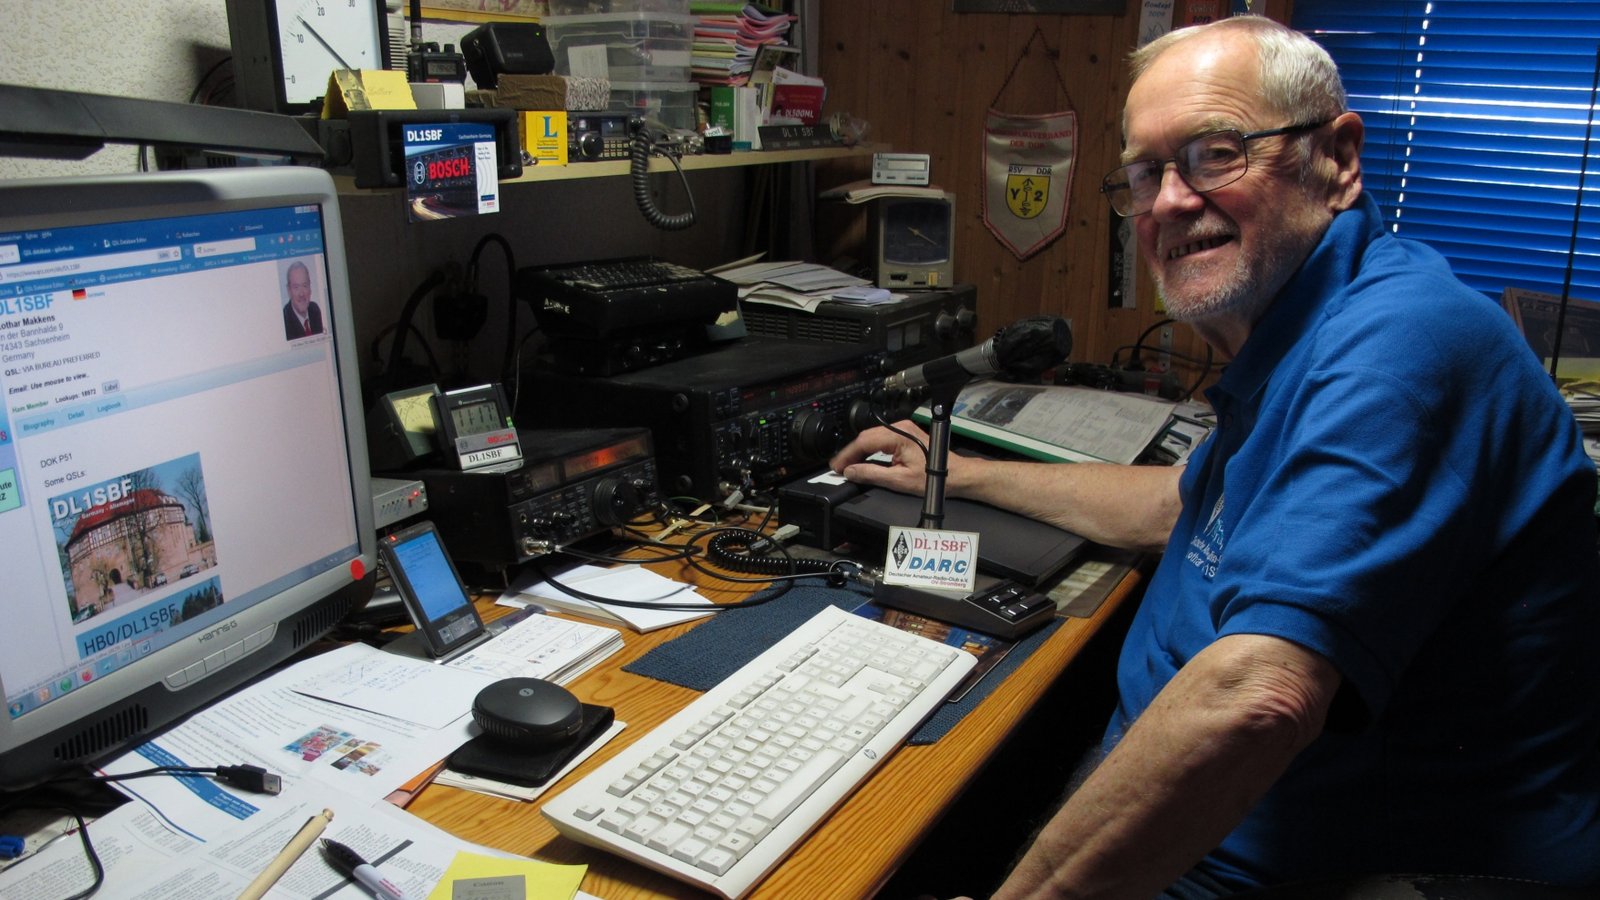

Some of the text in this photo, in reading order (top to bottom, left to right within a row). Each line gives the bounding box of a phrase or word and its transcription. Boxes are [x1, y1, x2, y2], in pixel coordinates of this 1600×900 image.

[317, 7, 326, 17] 20
[296, 34, 304, 44] 10
[291, 75, 296, 84] 0
[543, 116, 558, 138] L
[782, 128, 792, 138] DL
[801, 127, 814, 136] SBF
[407, 129, 442, 143] DL1SBF
[429, 157, 470, 180] BOSCH
[1008, 165, 1053, 175] RSV DDR
[1010, 188, 1044, 202] Y 2
[0, 314, 56, 331] othar Makkens
[7, 330, 19, 340] der
[21, 325, 57, 338] Bannhalde
[59, 322, 64, 332] 9
[24, 333, 71, 348] Sachsenheim
[2, 350, 36, 364] Germany
[5, 351, 101, 378] QSL: VIA BUREAU PREFERRED
[9, 385, 28, 395] Email:
[31, 382, 43, 391] Use
[44, 378, 65, 388] mouse
[27, 400, 49, 410] Member
[23, 401, 121, 432] Biography Detail Logbook
[40, 452, 73, 469] DOK P51
[469, 449, 503, 463] DL1SBF
[44, 477, 65, 488] Some
[52, 478, 134, 520] DL1SBF
[914, 537, 968, 552] DL1SBF
[909, 557, 968, 574] DARC
[1185, 552, 1204, 567] othar
